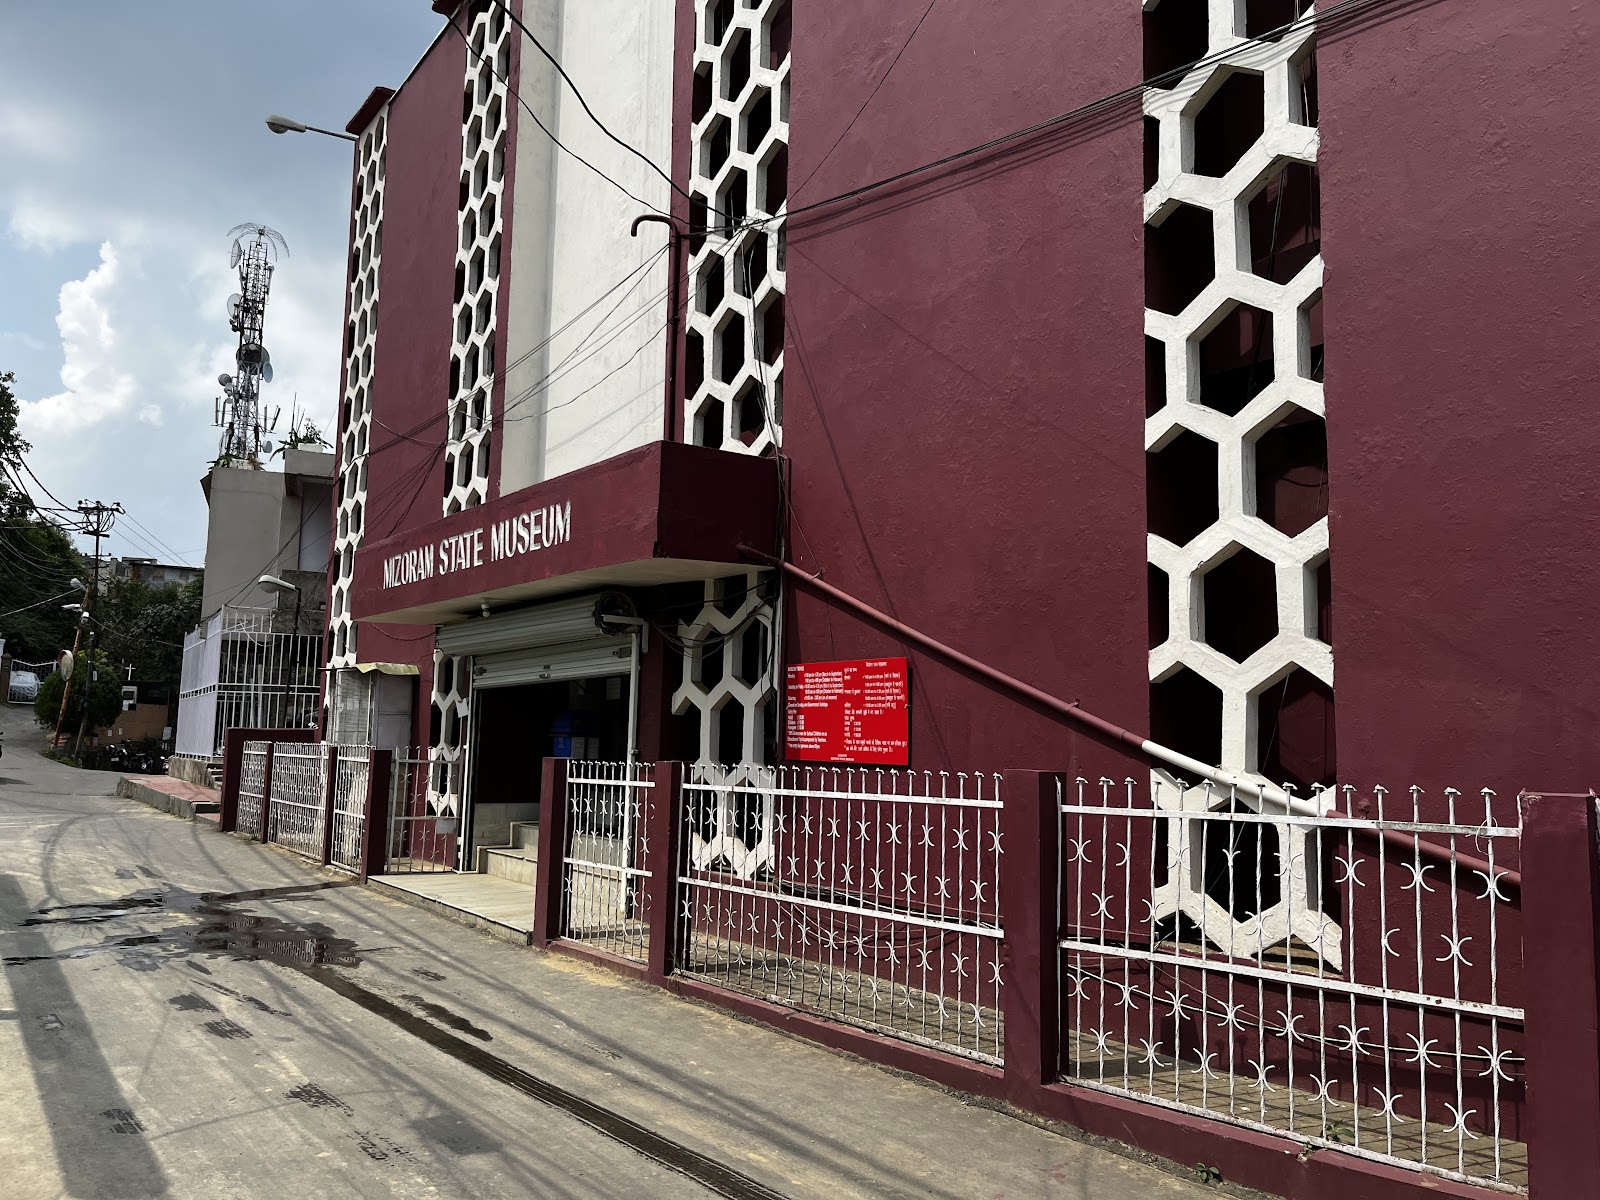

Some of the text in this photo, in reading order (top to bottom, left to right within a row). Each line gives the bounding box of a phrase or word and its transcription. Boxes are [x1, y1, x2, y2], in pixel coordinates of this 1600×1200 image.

[383, 499, 572, 590] MIZORAM STATE MUSEUM
